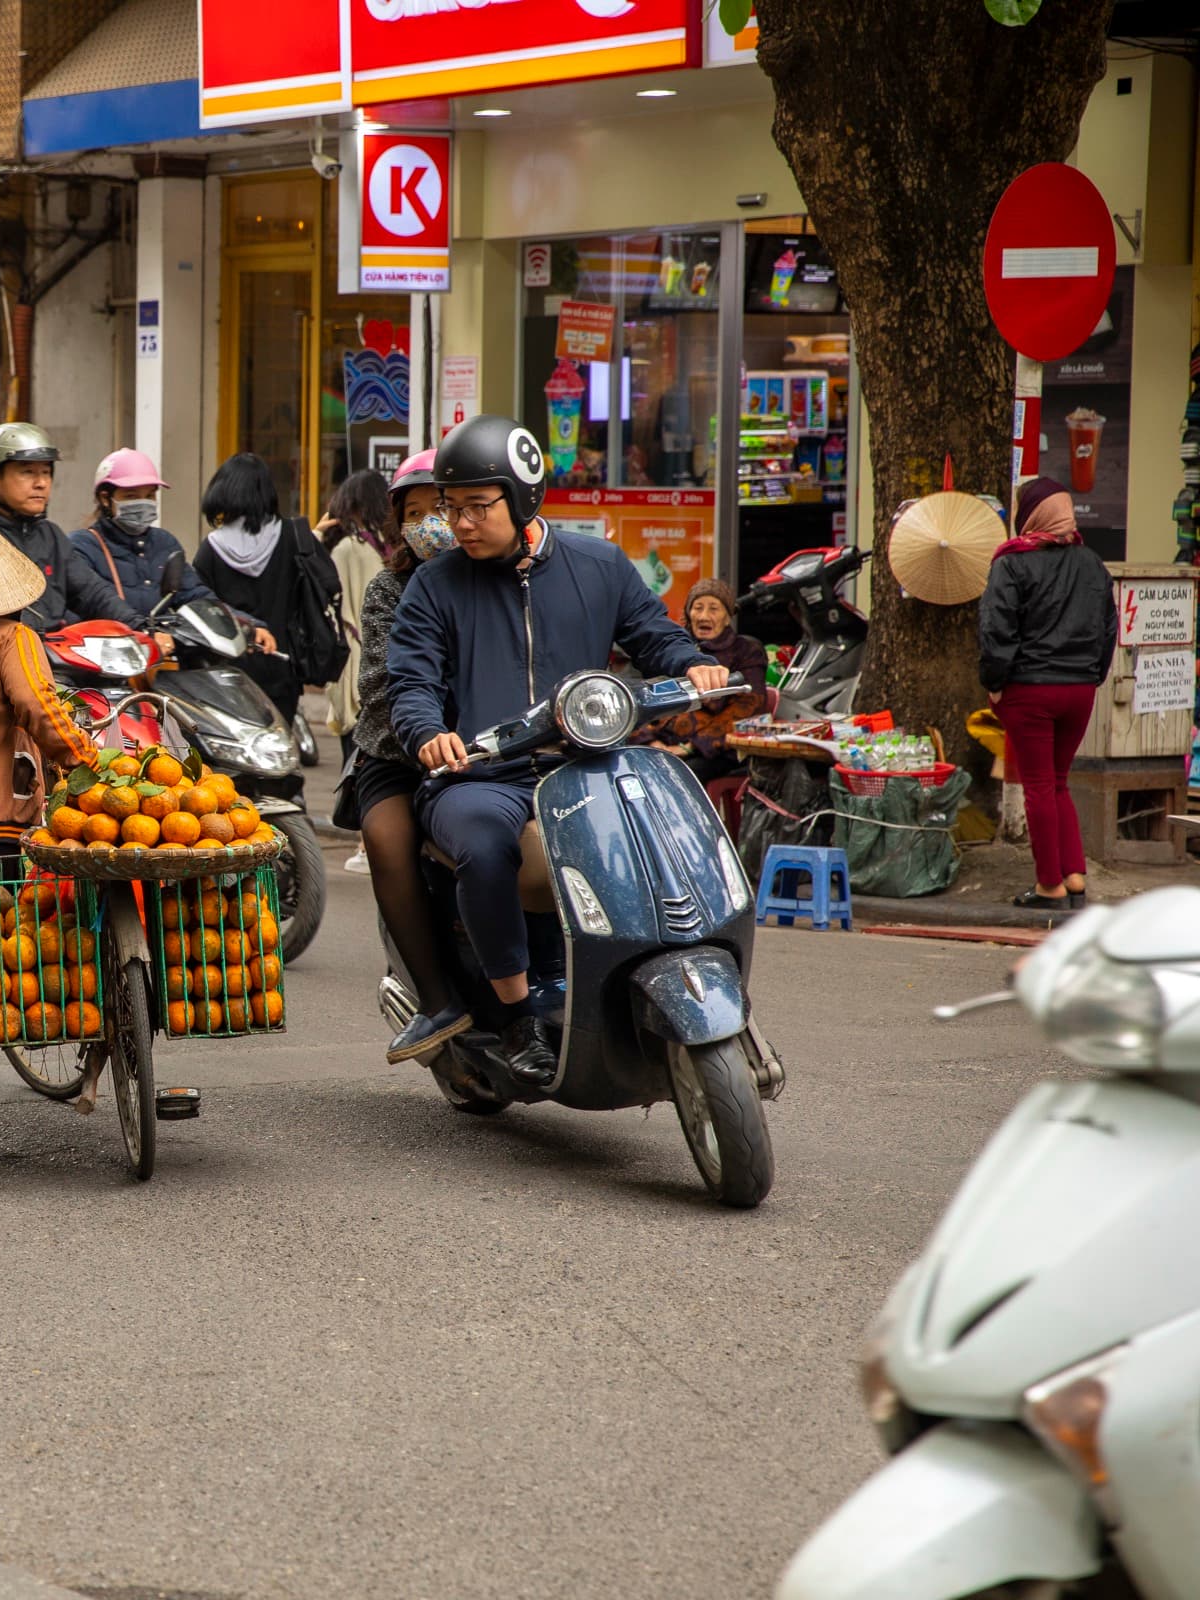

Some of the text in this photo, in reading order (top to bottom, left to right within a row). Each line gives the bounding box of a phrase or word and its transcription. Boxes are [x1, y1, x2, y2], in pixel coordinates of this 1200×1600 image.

[385, 271, 408, 282] HÀNG
[410, 271, 428, 282] TIỆN
[378, 453, 400, 469] THE
[516, 435, 541, 474] 8
[1151, 608, 1161, 618] CÓ
[1144, 655, 1185, 670] BÁN NHÀ
[552, 795, 598, 821] Vespa
